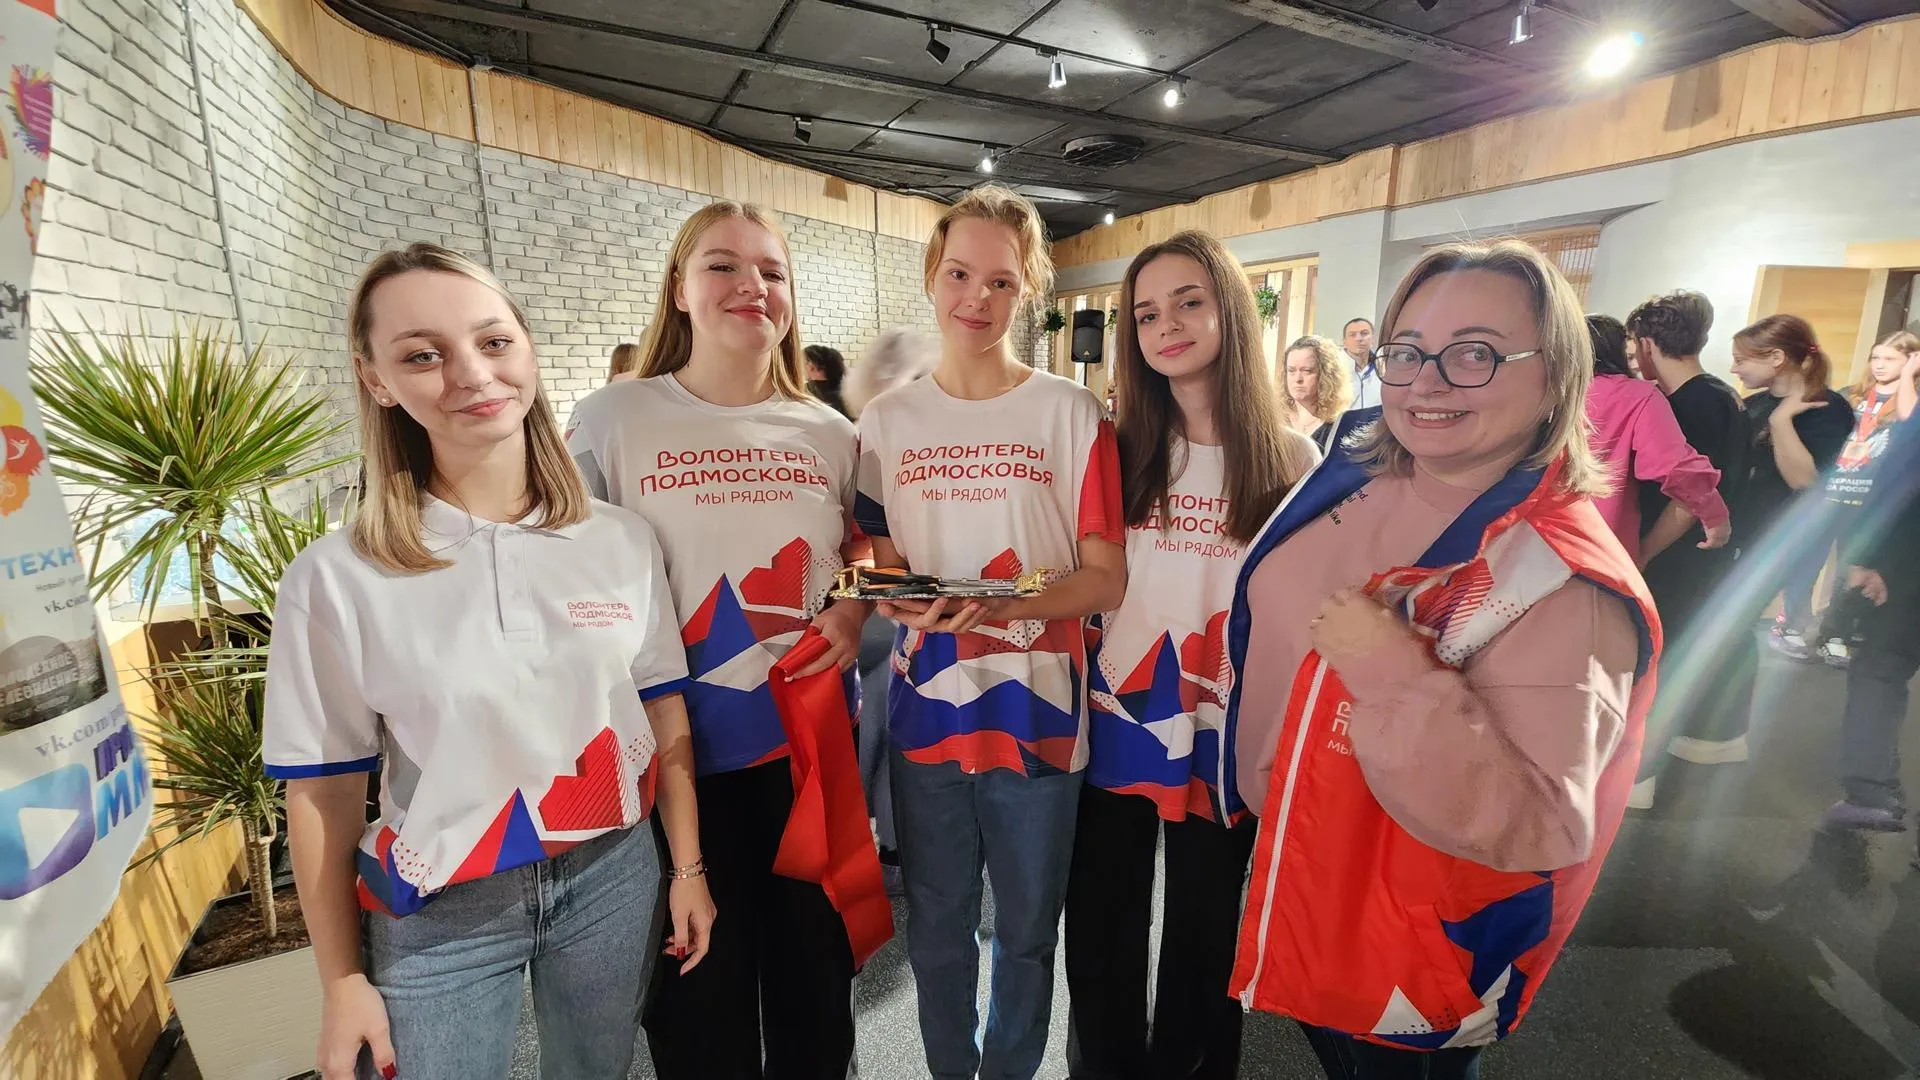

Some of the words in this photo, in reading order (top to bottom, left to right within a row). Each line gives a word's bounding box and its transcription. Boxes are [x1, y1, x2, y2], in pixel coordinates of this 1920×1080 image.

[657, 448, 818, 469] ВОЛОНТЕРЫ
[901, 443, 1045, 466] ВОЛОНТЕРЫ
[640, 467, 830, 496] ПОДМОСКОВЬЯ
[893, 462, 1053, 492] ПОДМОСКОВЬЯ
[695, 492, 725, 506] МЫ
[731, 489, 794, 504] РЯДОМ
[921, 488, 947, 501] МЫ
[951, 487, 1007, 503] РЯДОМ
[1154, 539, 1180, 553] МЫ
[1184, 541, 1238, 560] РЯДОМ
